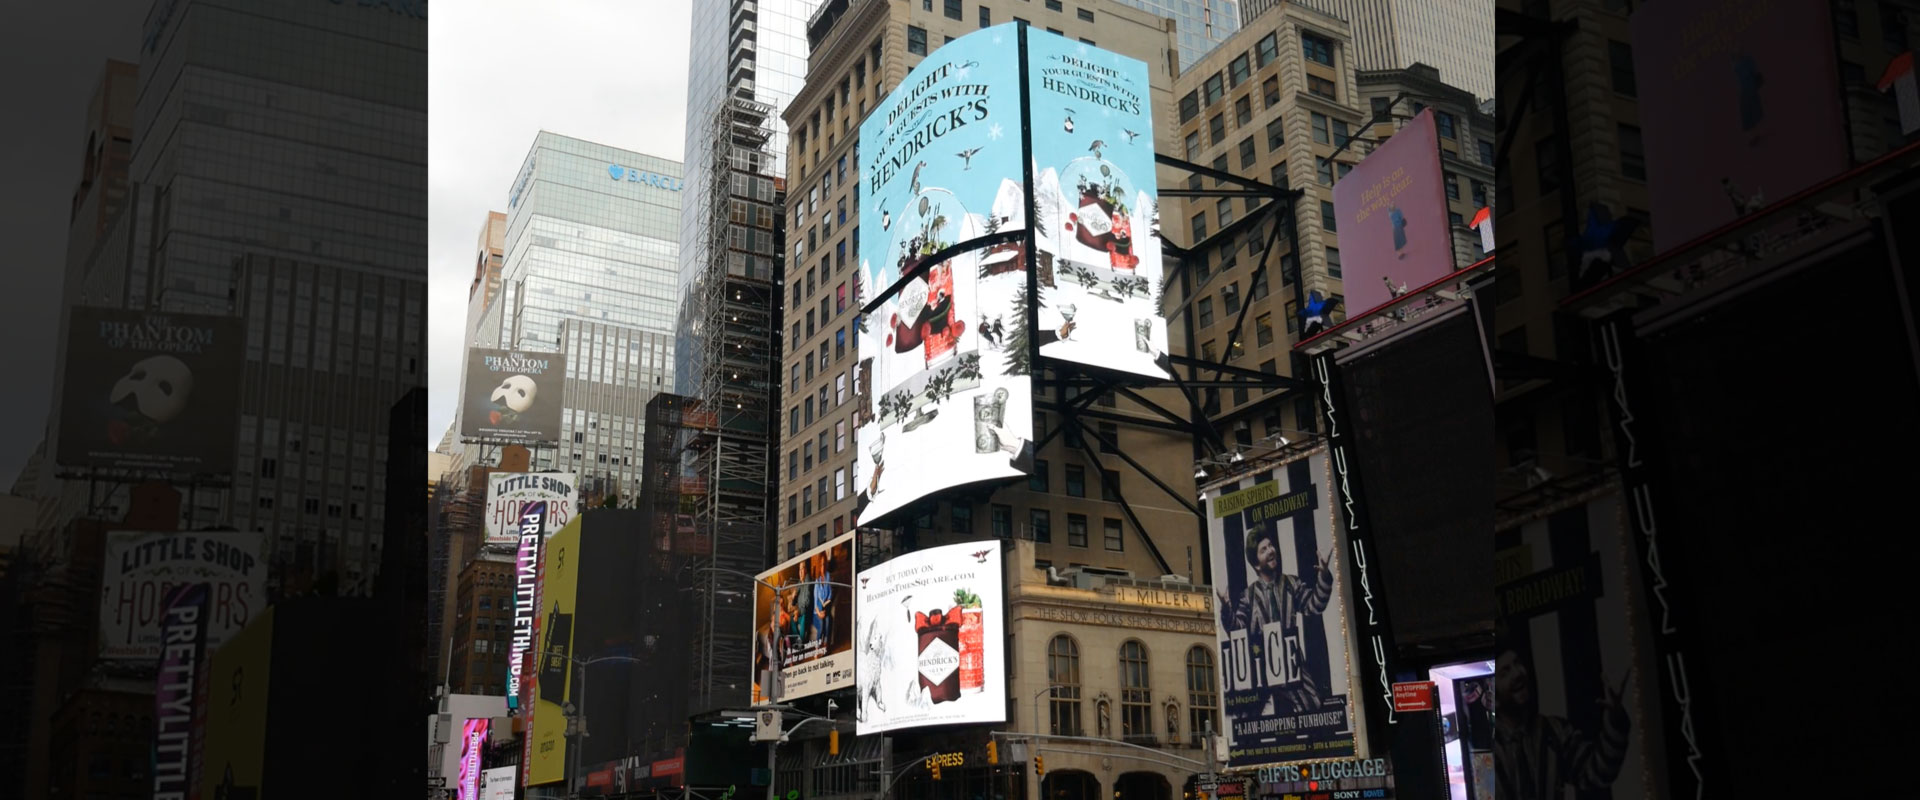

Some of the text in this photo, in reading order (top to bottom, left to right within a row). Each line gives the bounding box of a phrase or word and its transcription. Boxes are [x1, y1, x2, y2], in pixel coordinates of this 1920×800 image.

[1062, 54, 1120, 79] DELIGHT
[888, 61, 951, 126] DELIGHT
[1042, 68, 1140, 103] YOUR GUESTS WITH
[1042, 77, 1140, 116] HENDRICK'S
[870, 84, 989, 172] YOUR GUESTS WITH
[870, 98, 988, 197] HENDRICK'S
[1361, 167, 1404, 205] Help is on
[1356, 208, 1370, 224] the
[102, 320, 216, 346] PHANTOM
[485, 356, 548, 370] PHANTOM
[517, 366, 542, 375] OPERA
[497, 476, 571, 497] LITTLE SHOP
[1218, 485, 1274, 512] RAISING SPIRITS
[1252, 493, 1308, 522] ON BROADWAY!
[124, 536, 257, 575] LITTLE SHOP
[886, 564, 934, 584] BUY TODAY ON
[510, 514, 540, 697] PRETTYLITTLETHING.COM
[1137, 590, 1192, 608] MILLER
[1038, 608, 1056, 619] THE
[1060, 610, 1088, 622] SHOW
[1094, 612, 1123, 626] FOLKS
[1128, 615, 1152, 628] SHOE
[1156, 618, 1180, 630] SHOP
[919, 656, 958, 667] HENDRICK'S
[1244, 716, 1296, 734] JAW-DROPPING
[926, 752, 964, 769] EXPRESS
[1258, 758, 1386, 784] GIFTS LUGGAGE
[1318, 780, 1334, 790] NY
[1334, 790, 1360, 800] SONY
